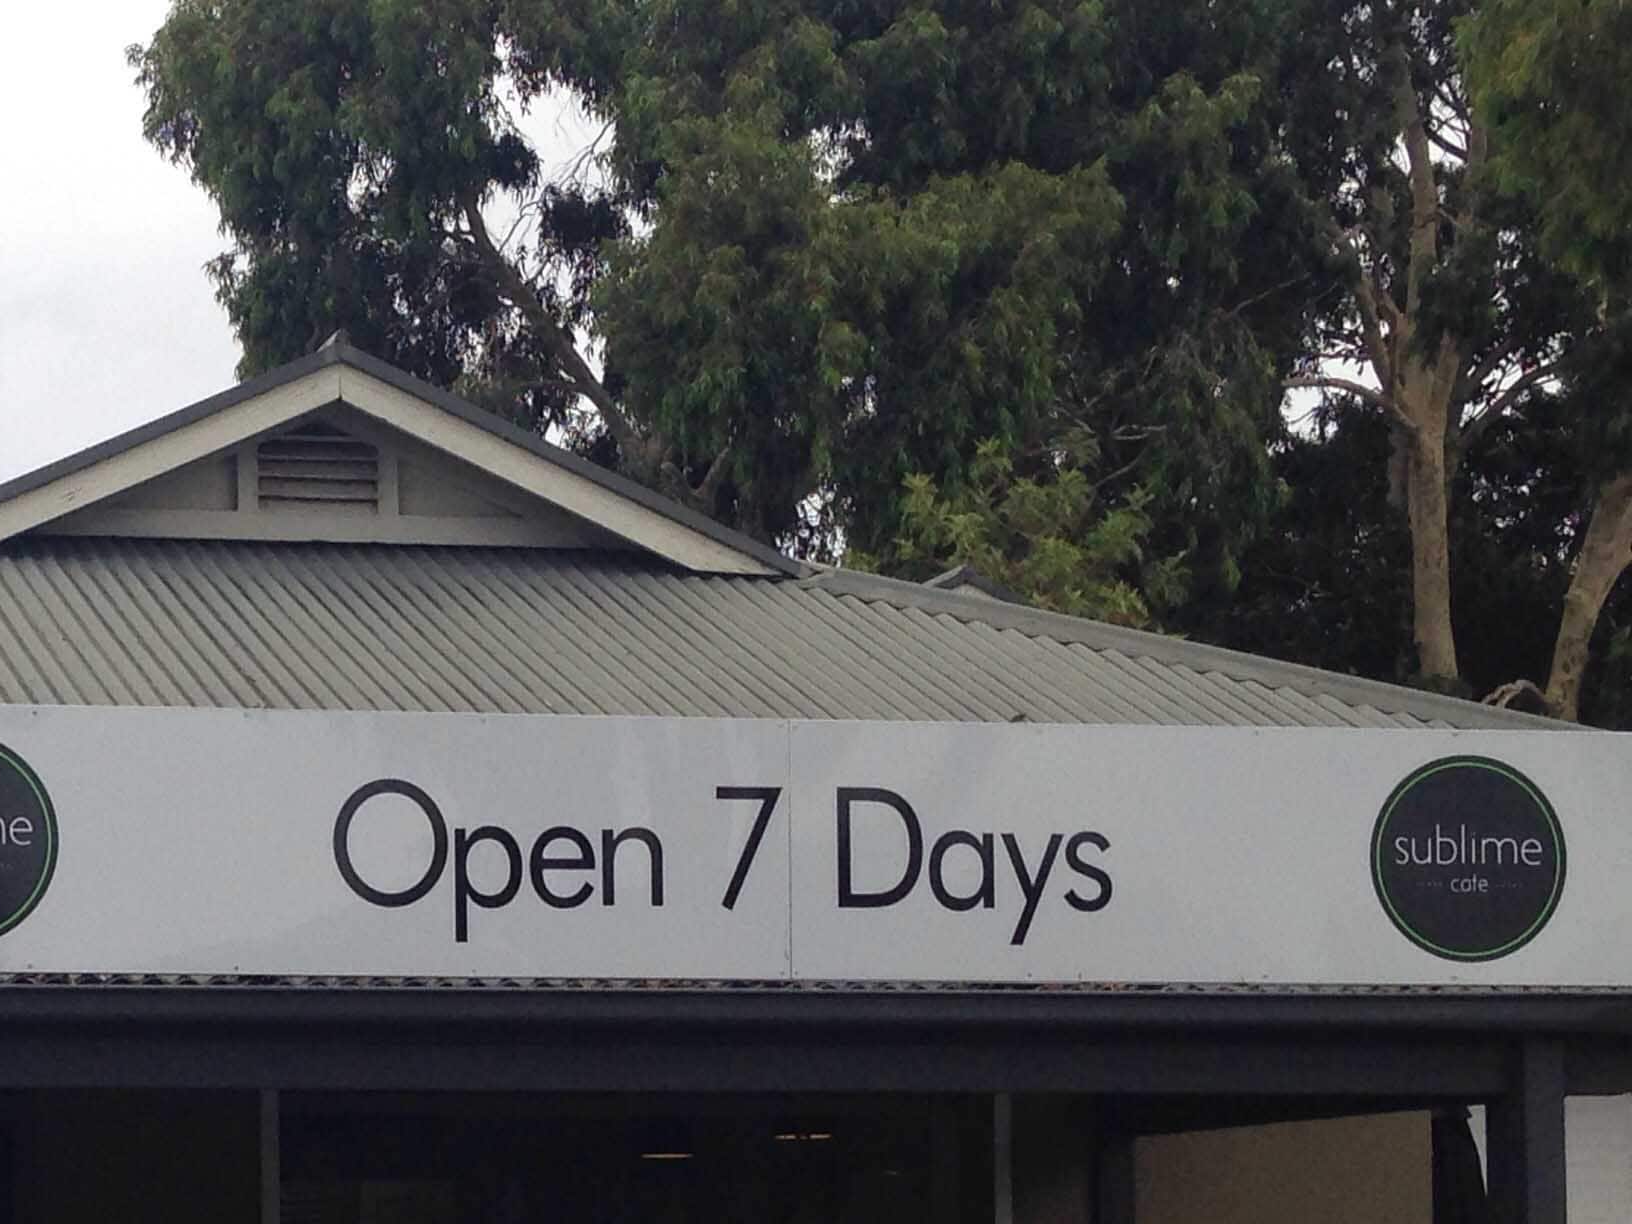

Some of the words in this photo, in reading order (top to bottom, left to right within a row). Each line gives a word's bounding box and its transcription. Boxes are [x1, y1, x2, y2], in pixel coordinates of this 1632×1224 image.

[333, 778, 664, 942] Open
[715, 787, 782, 909] 7
[836, 787, 1112, 945] Days
[1394, 824, 1543, 866] sublime
[1449, 874, 1489, 892] cafe
